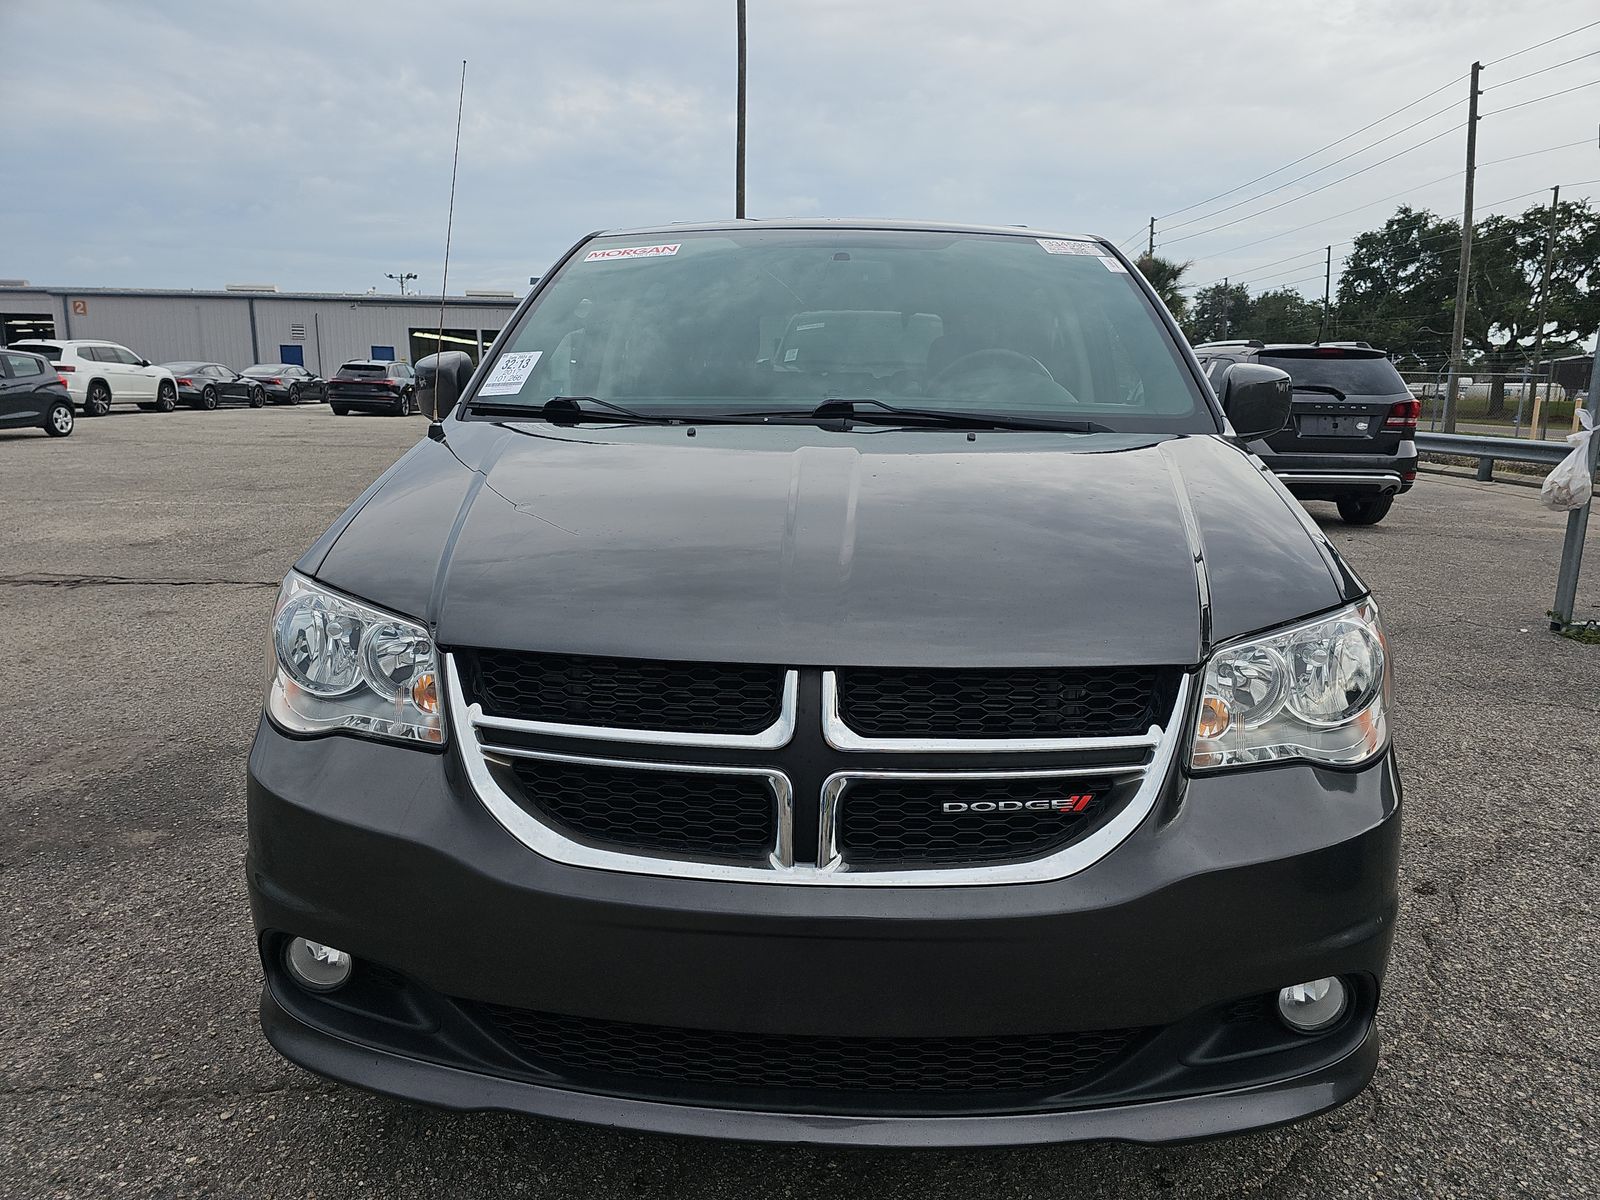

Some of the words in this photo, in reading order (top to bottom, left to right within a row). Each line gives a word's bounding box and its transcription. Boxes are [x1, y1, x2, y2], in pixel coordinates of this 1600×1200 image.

[588, 245, 678, 258] MORGAN
[75, 301, 84, 313] 2
[501, 358, 531, 370] 32:13
[943, 799, 1074, 812] DODGE
